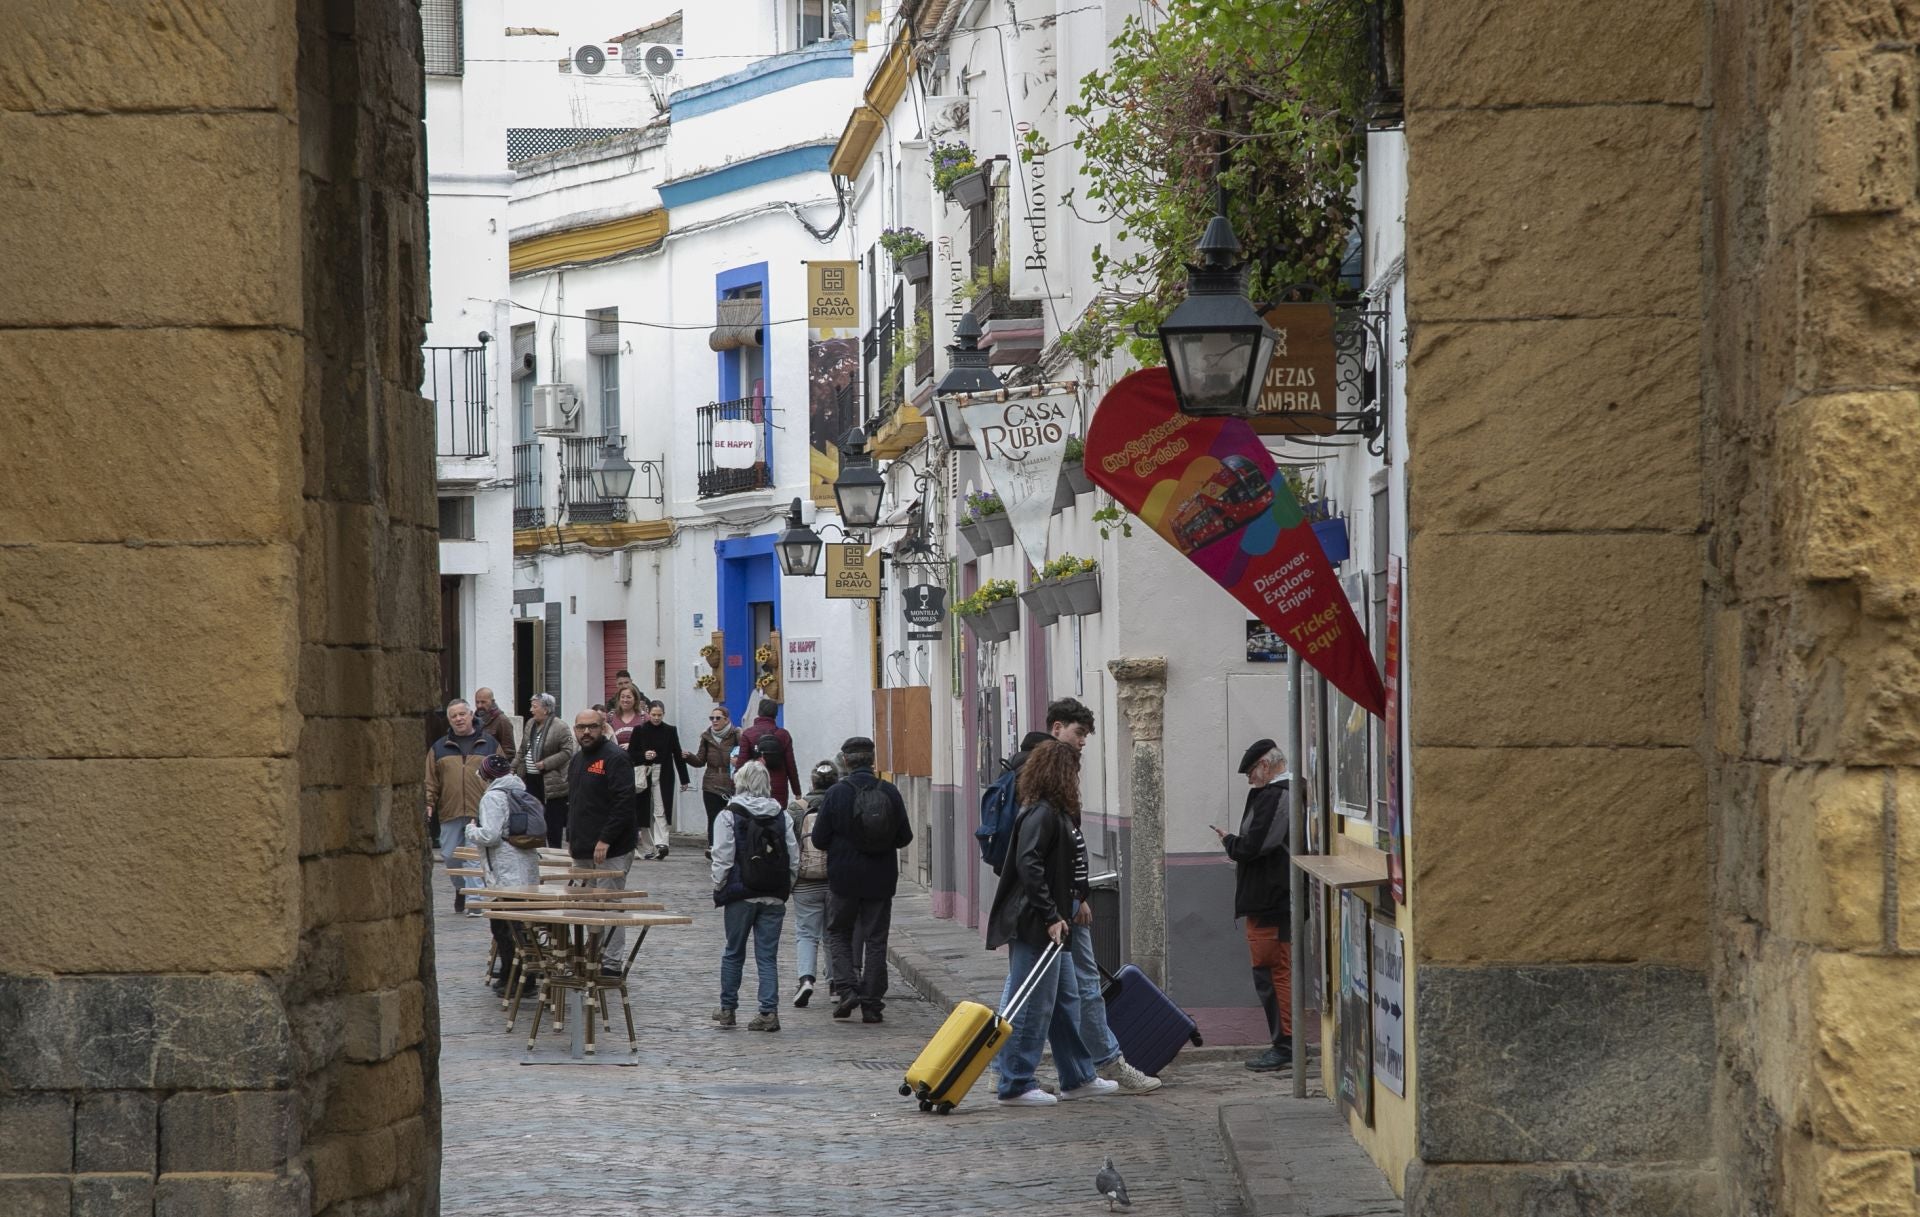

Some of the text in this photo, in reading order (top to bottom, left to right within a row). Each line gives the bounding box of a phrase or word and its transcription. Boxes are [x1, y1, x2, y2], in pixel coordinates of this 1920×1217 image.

[1024, 152, 1047, 272] Beethoven
[812, 306, 855, 316] BRAVO
[816, 297, 850, 306] CASA
[1265, 367, 1316, 387] VEZAS
[1256, 391, 1321, 411] AMBRA
[1003, 402, 1066, 428] CASA
[714, 440, 753, 449] BE HAPPY
[1134, 437, 1189, 478] Córdoba
[835, 579, 872, 588] BRAVO
[839, 571, 868, 580] CASA
[1253, 552, 1310, 593] Discover.
[1263, 568, 1315, 605] Explore.
[1277, 586, 1315, 614] Enjoy.
[1289, 602, 1342, 642] Ticket
[1307, 620, 1342, 654] aquí
